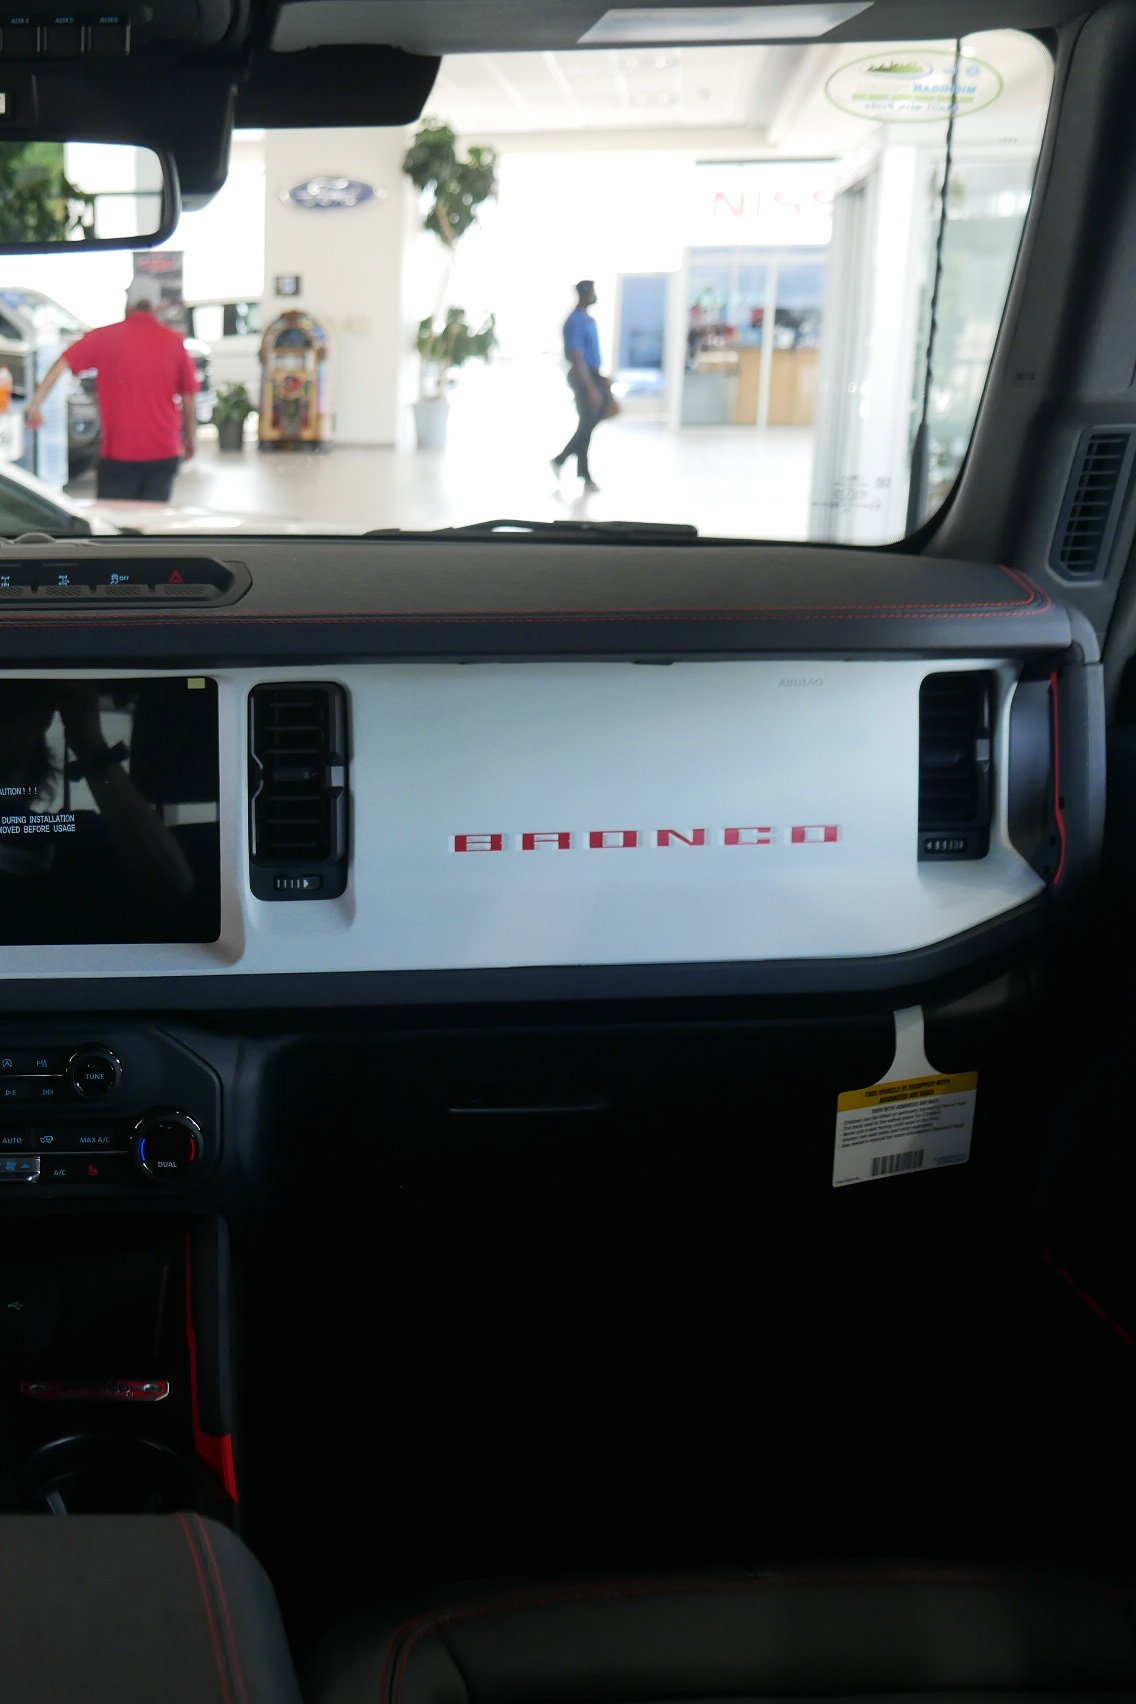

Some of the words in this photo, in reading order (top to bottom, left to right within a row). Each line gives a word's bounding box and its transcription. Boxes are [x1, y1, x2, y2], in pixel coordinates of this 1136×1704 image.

[1, 816, 26, 824] DURING
[30, 815, 74, 823] INSTALLATION
[54, 824, 76, 832] USAGE
[452, 824, 840, 853] BRONCO
[2, 1137, 23, 1145] AUTO
[79, 1136, 96, 1144] MAX
[97, 1136, 111, 1144] A/C
[157, 1161, 177, 1169] DUAL
[53, 1169, 67, 1177] A/C
